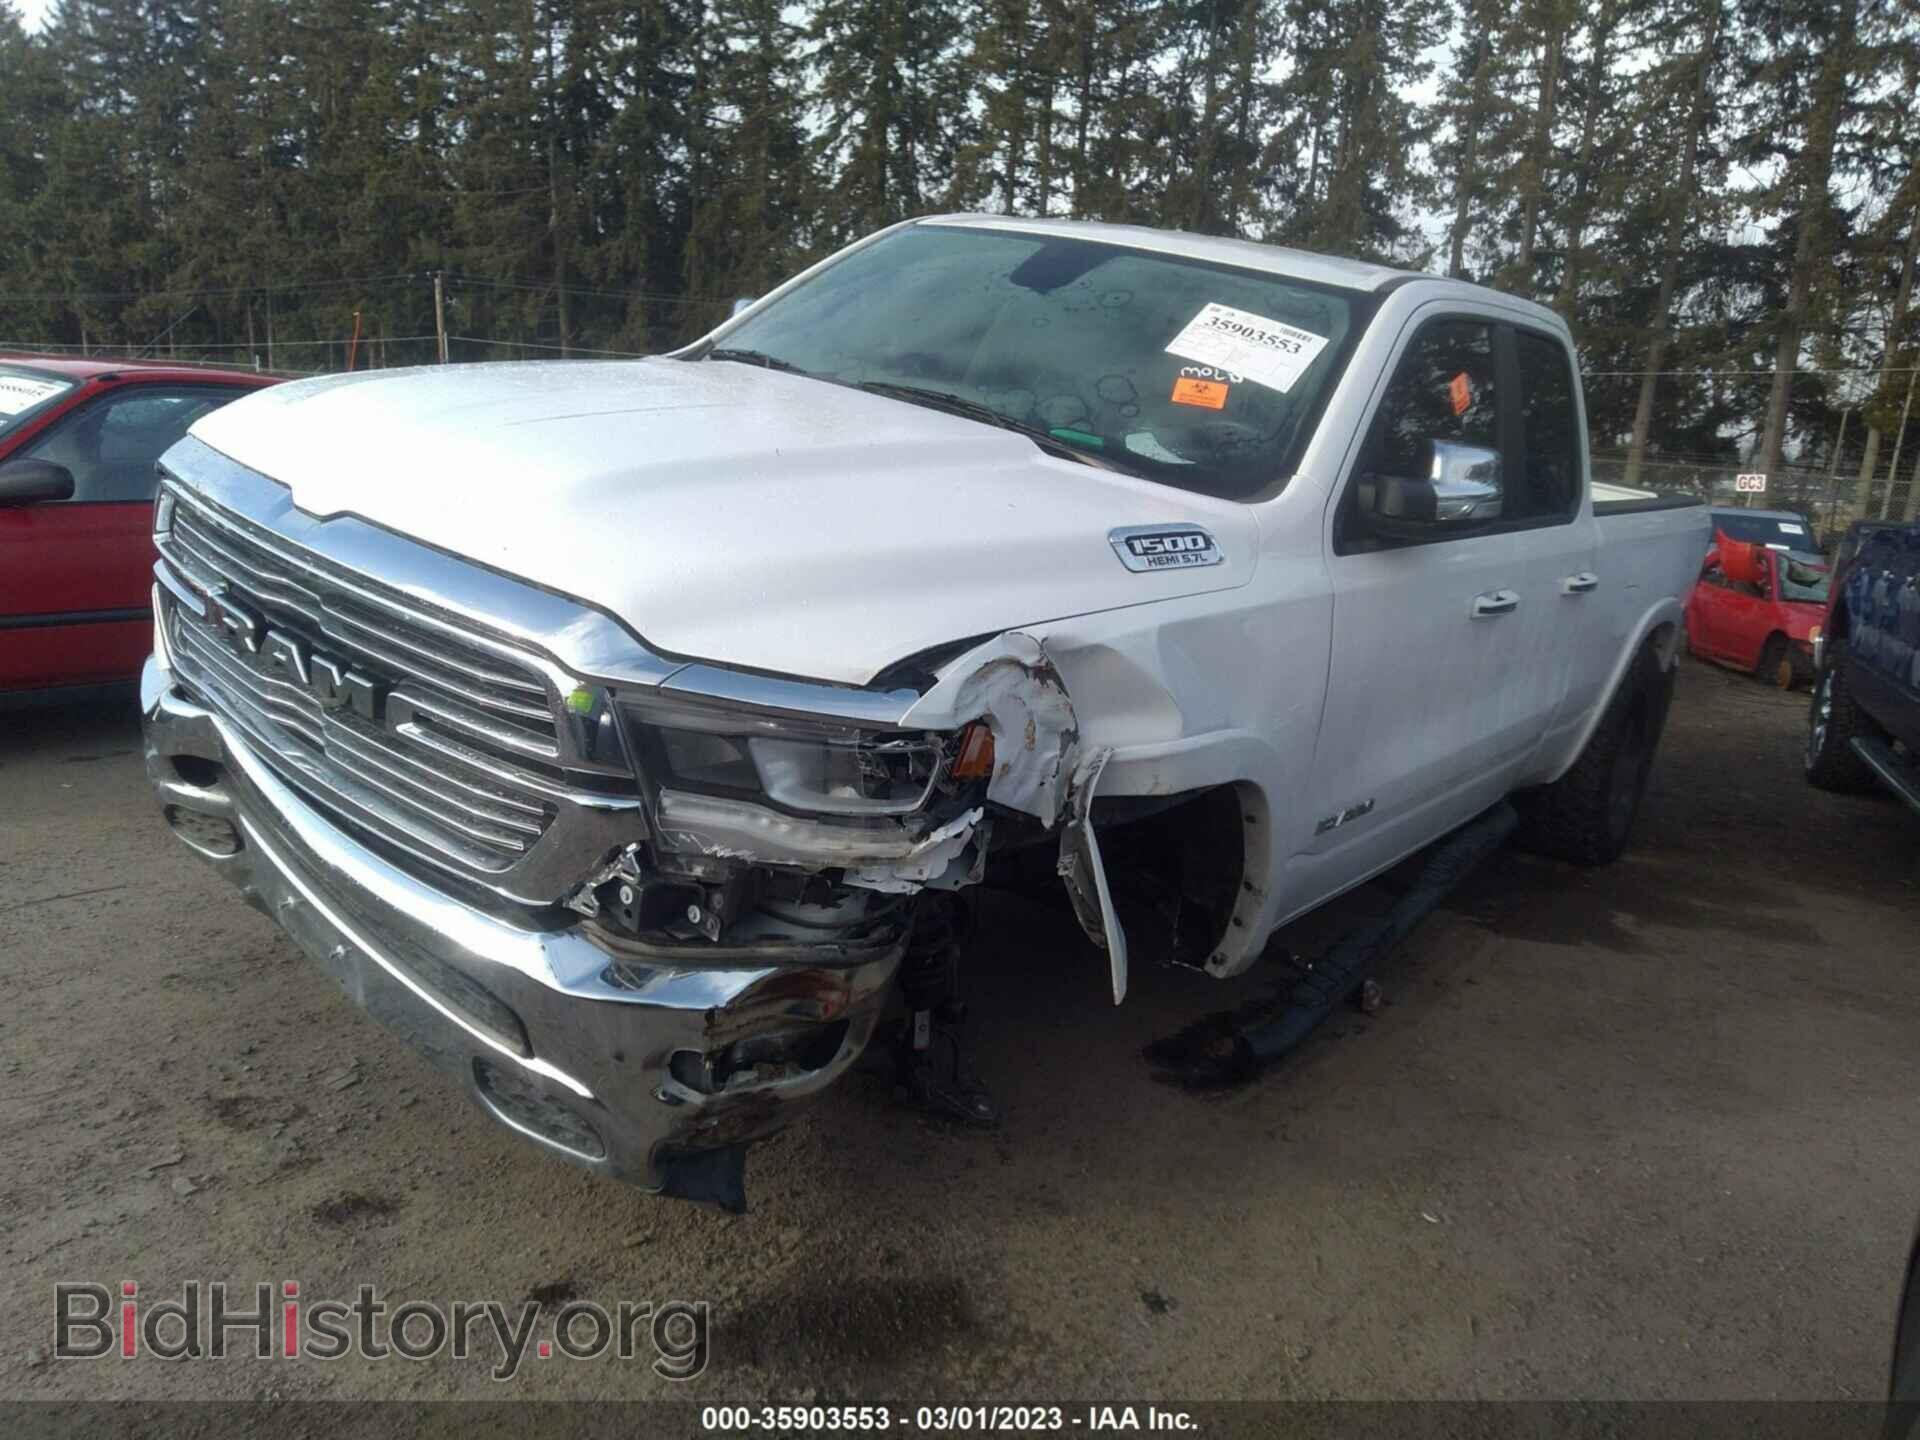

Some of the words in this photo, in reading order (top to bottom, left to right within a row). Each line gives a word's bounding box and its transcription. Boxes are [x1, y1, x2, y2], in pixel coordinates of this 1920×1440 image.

[1204, 316, 1303, 354] 35903553
[1738, 476, 1764, 490] GC3
[1129, 535, 1206, 555] 1500
[1146, 555, 1181, 567] HEMI
[1182, 553, 1208, 565] 5.7L
[207, 590, 377, 720] RAM
